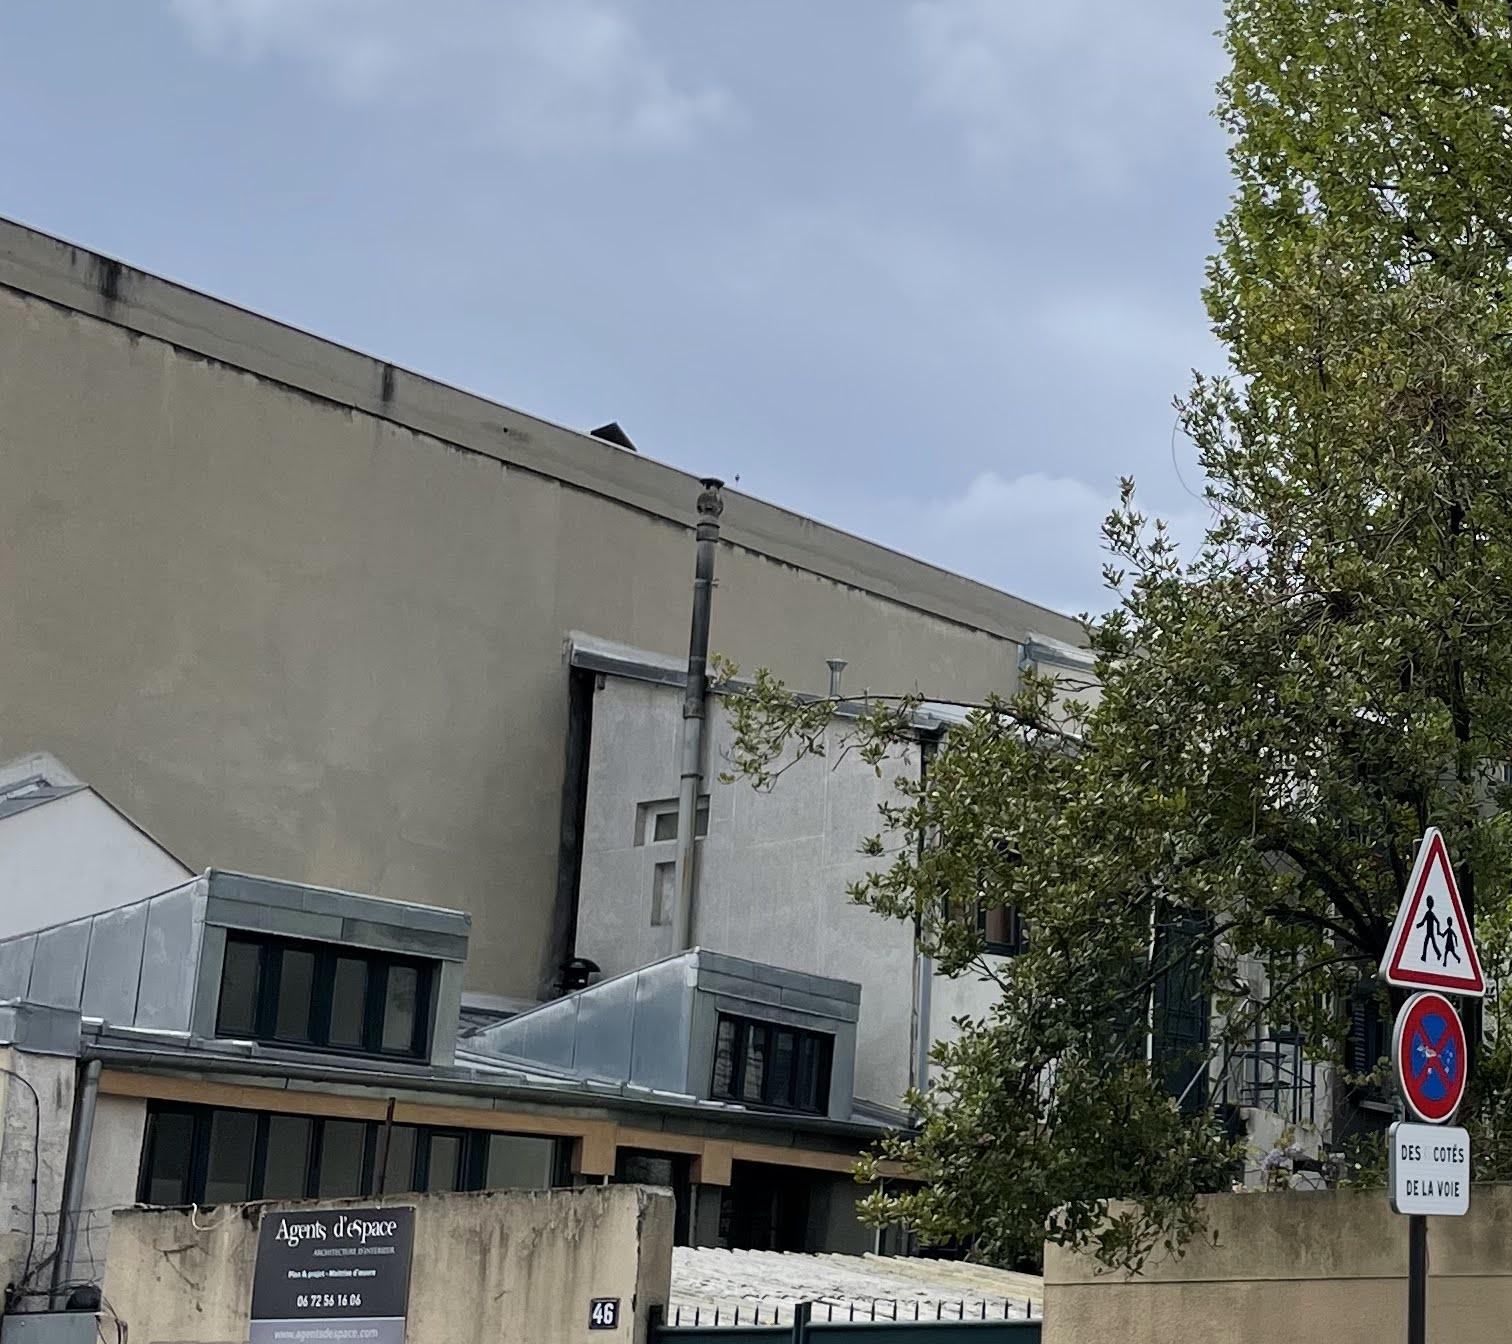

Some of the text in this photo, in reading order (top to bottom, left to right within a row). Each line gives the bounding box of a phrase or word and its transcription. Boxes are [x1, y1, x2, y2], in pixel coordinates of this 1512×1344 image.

[1401, 1144, 1421, 1161] DES
[1406, 1179, 1460, 1197] DE LA VOIE
[275, 1218, 327, 1247] Agents
[297, 1293, 361, 1307] 06 72 56 16 06
[592, 1302, 614, 1324] 46
